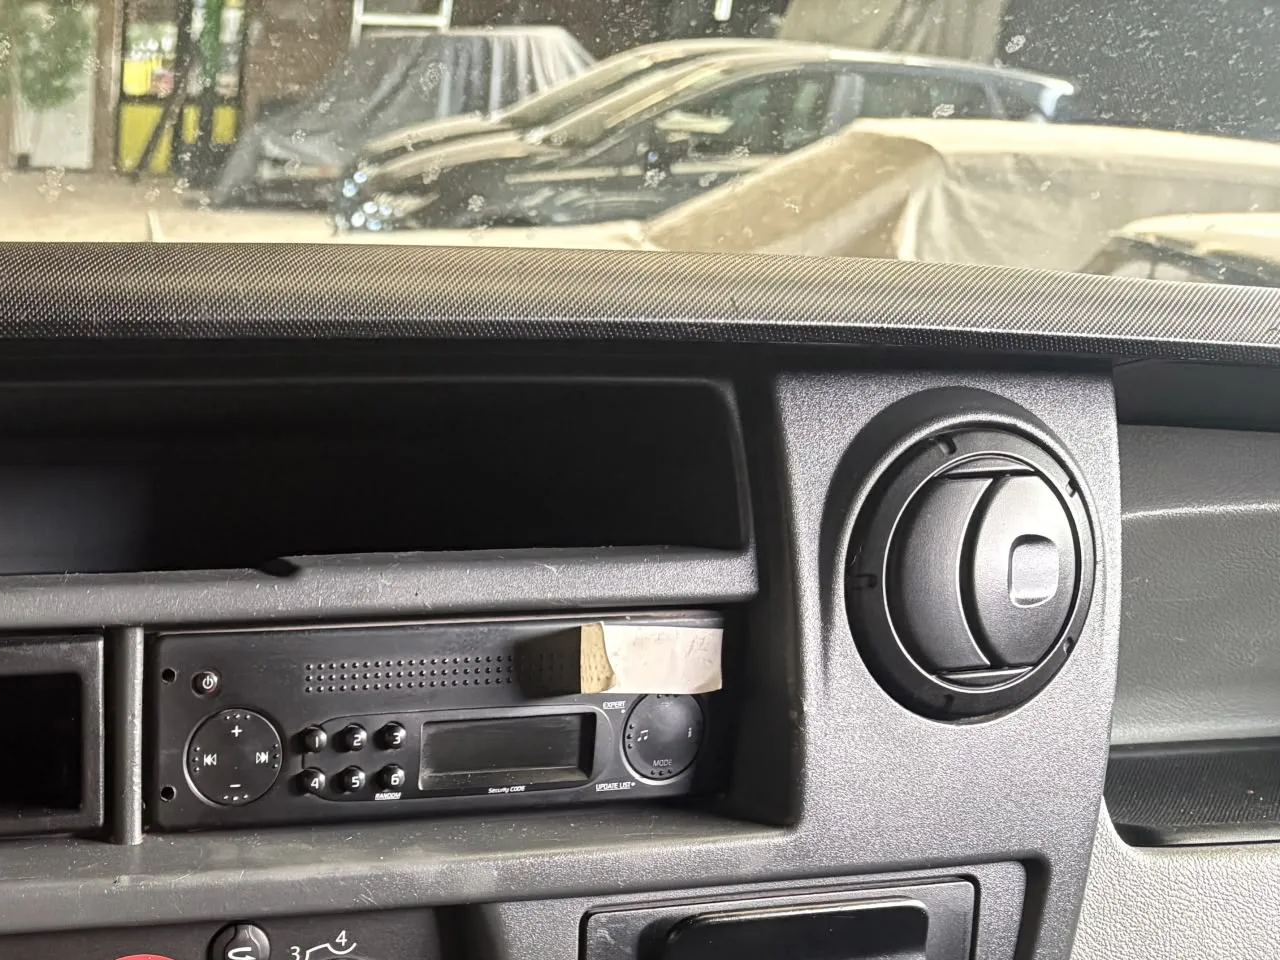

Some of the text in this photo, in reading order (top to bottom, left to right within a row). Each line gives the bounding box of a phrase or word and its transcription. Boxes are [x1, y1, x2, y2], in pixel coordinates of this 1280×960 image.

[603, 700, 626, 709] EXPERT
[315, 736, 319, 748] 1
[353, 734, 361, 747] 2
[392, 732, 401, 744] 3
[653, 759, 673, 767] MODE
[310, 777, 319, 789] 4
[351, 776, 360, 788] 5
[390, 774, 400, 786] 6
[595, 782, 632, 792] UPDATE LIST
[375, 792, 402, 801] RANDOM
[335, 930, 348, 946] 4
